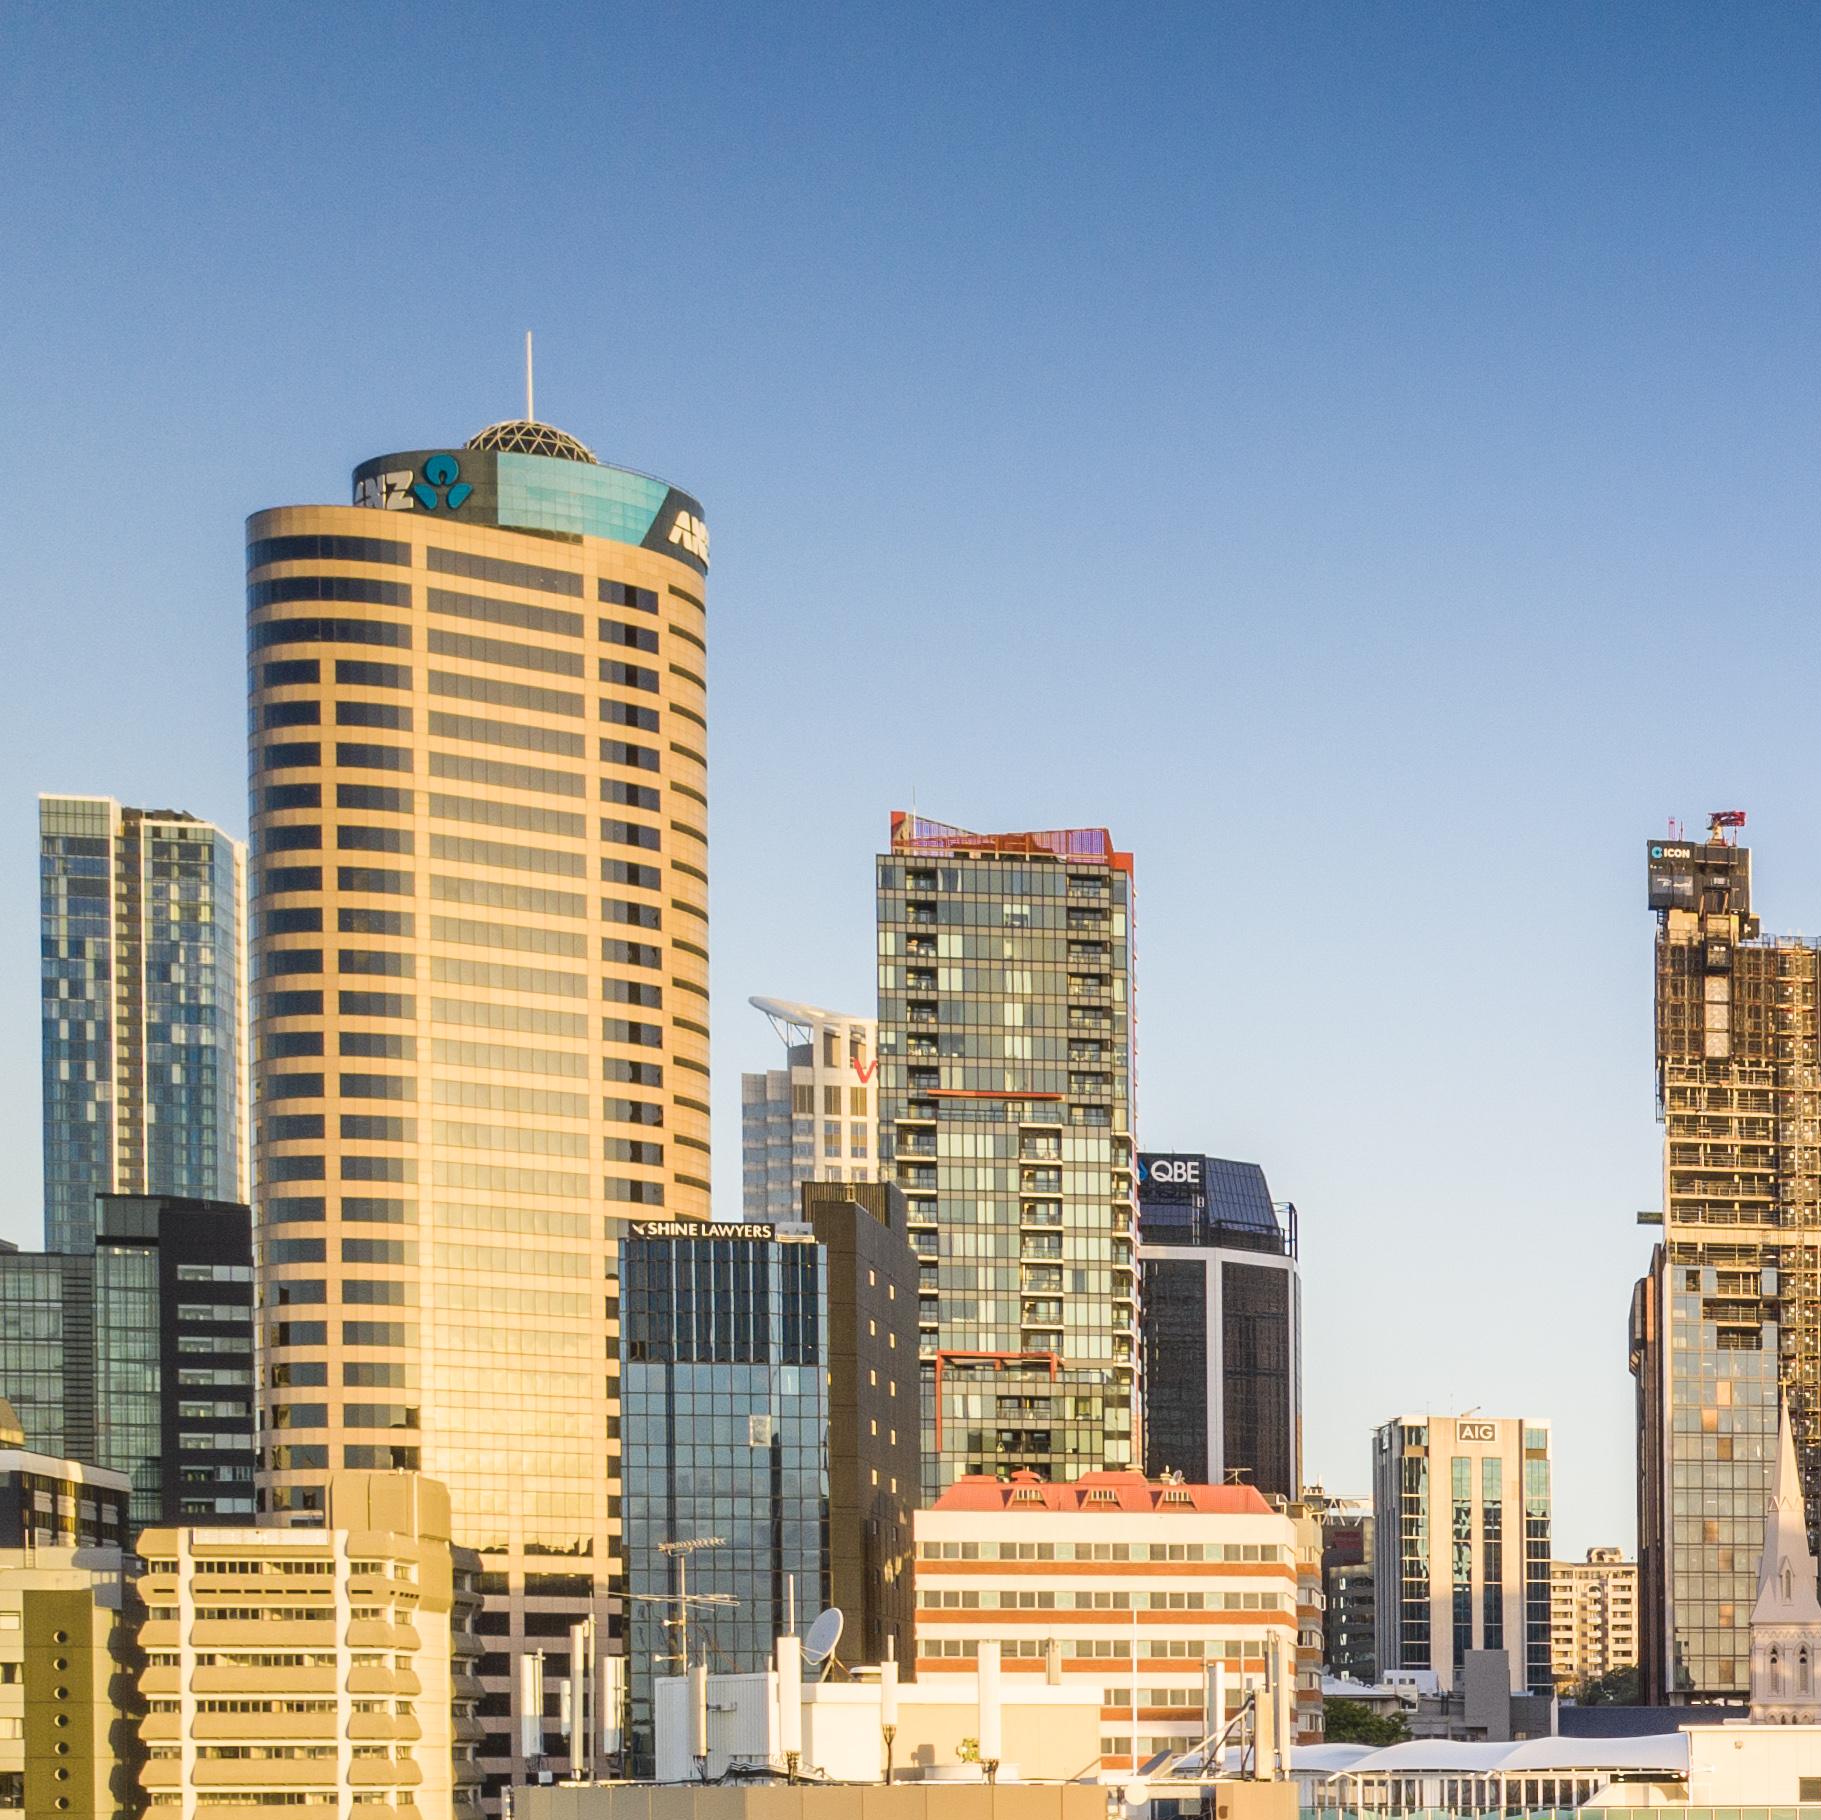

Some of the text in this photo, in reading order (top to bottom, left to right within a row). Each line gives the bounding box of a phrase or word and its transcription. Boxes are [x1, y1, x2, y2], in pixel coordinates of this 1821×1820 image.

[352, 470, 415, 510] ANZ
[668, 510, 710, 568] AN
[1663, 847, 1690, 859] ICON
[1150, 1160, 1200, 1183] QBE
[649, 1222, 772, 1238] SHINE LAWYERS
[1461, 1425, 1493, 1440] AIG
